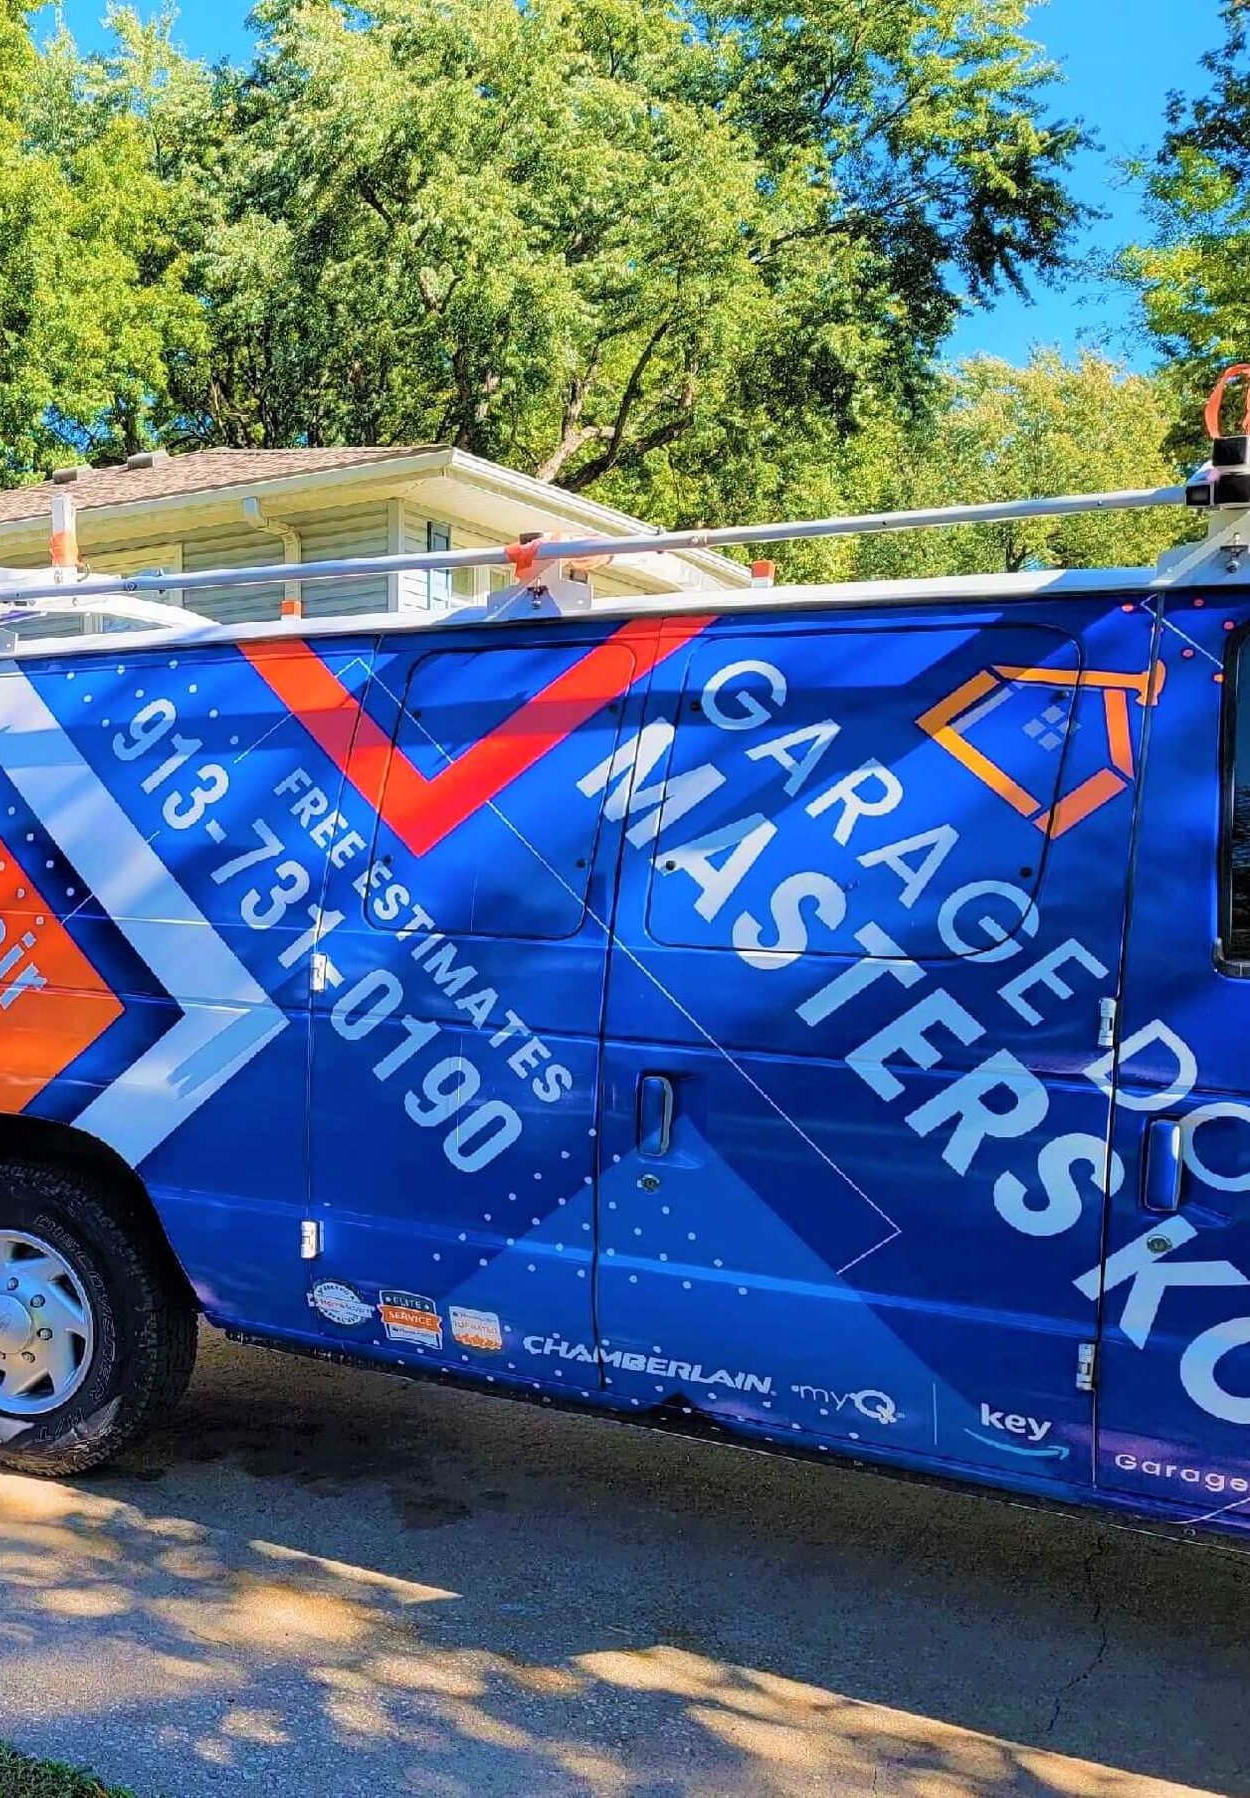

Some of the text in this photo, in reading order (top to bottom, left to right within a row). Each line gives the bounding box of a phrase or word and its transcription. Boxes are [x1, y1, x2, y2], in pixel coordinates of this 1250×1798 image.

[701, 659, 1109, 1026] GARAGE
[112, 698, 522, 1173] 913-731-0190
[273, 767, 573, 1103] FREE ESTIMATES
[576, 717, 1125, 1236] MASTERS
[388, 1310, 434, 1328] SERVICE
[522, 1335, 773, 1394] CHAMBERLAIN
[798, 1384, 897, 1425] myQ
[980, 1402, 1052, 1442] key
[1114, 1453, 1249, 1493] Garage
